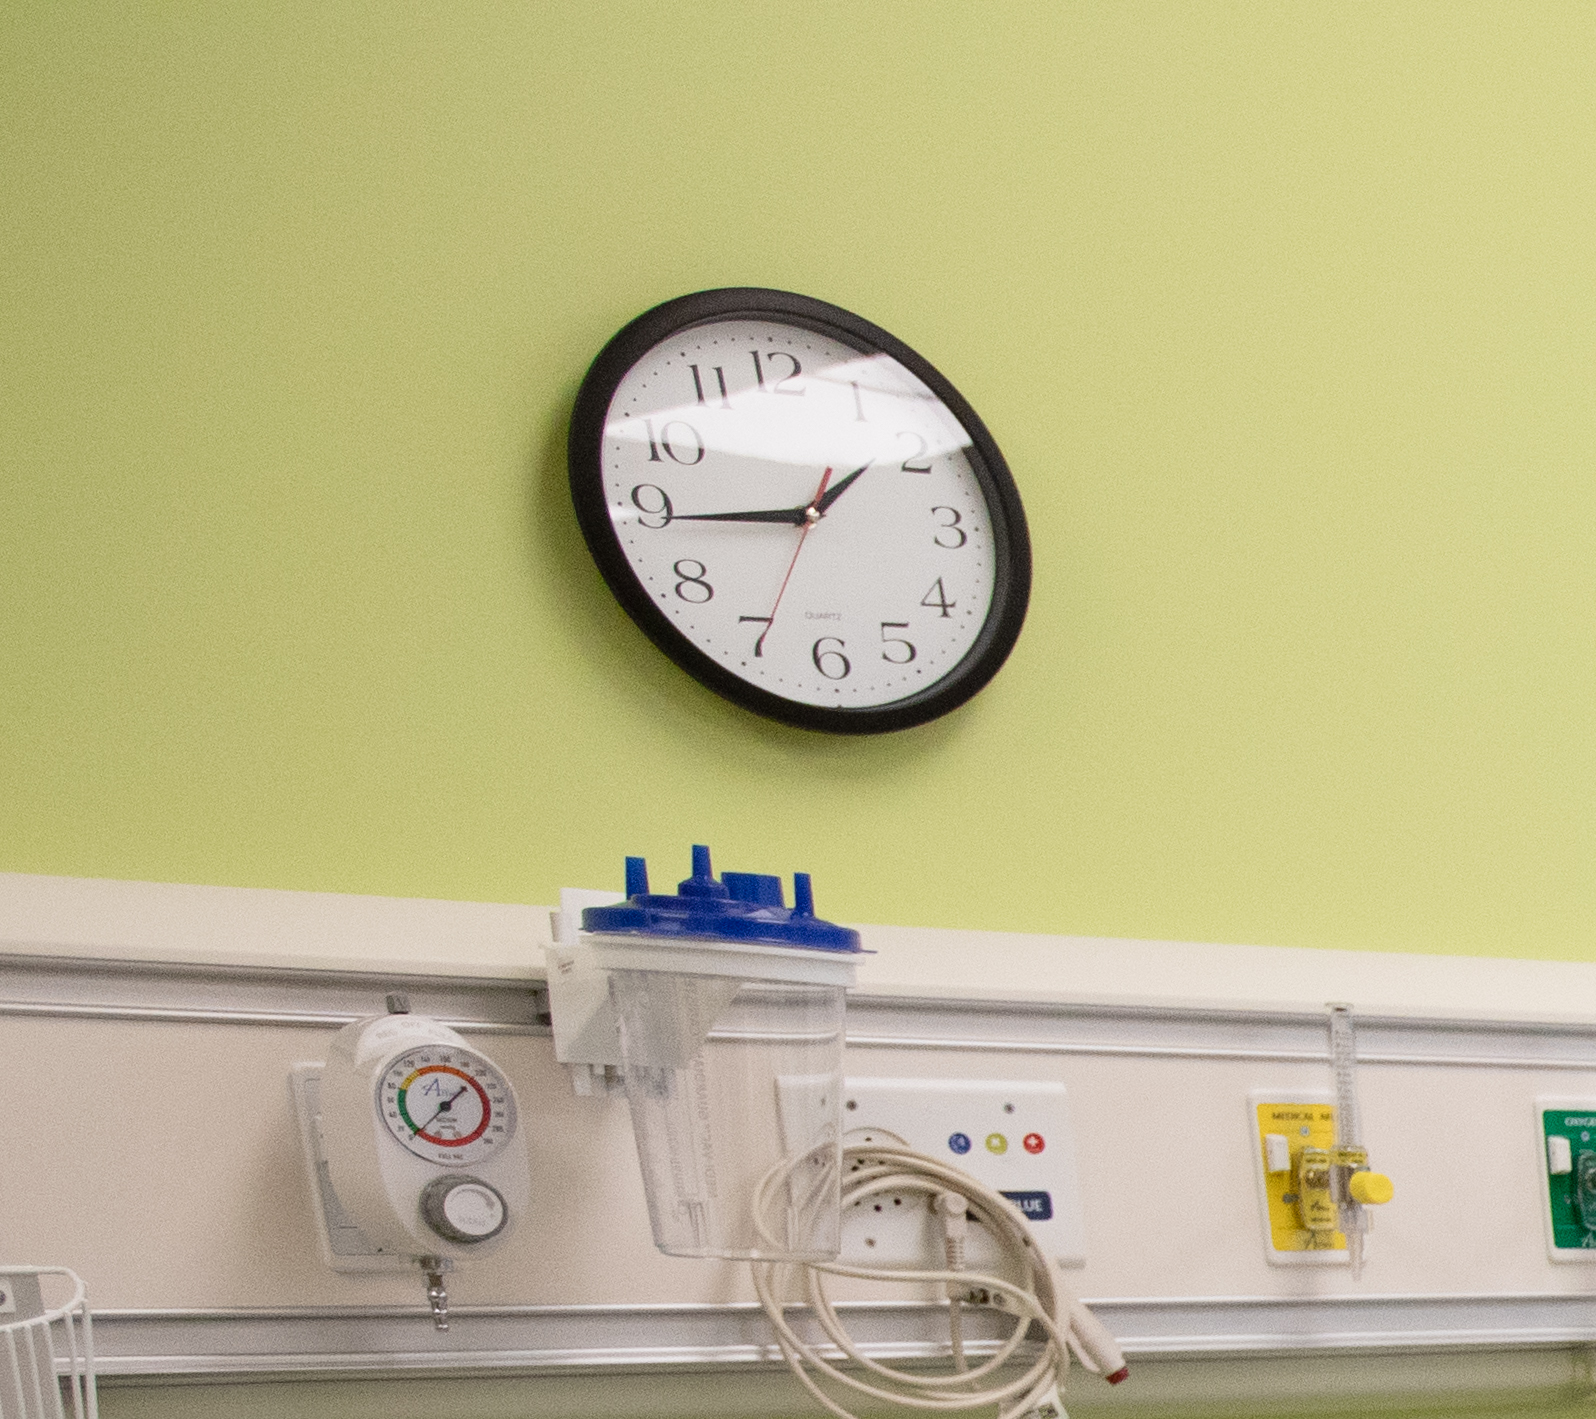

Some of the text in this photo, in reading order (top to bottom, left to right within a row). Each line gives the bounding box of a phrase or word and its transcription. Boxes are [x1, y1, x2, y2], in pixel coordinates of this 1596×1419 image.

[688, 364, 734, 410] 11
[749, 349, 807, 397] 12
[849, 380, 868, 422] 1
[643, 418, 705, 466] 10
[896, 431, 933, 474] 2
[630, 484, 674, 529] 9
[930, 506, 967, 549] 3
[673, 559, 714, 604] 8
[919, 576, 957, 618] 4
[738, 615, 774, 658] 7
[812, 636, 851, 680] 6
[880, 622, 917, 665] 5
